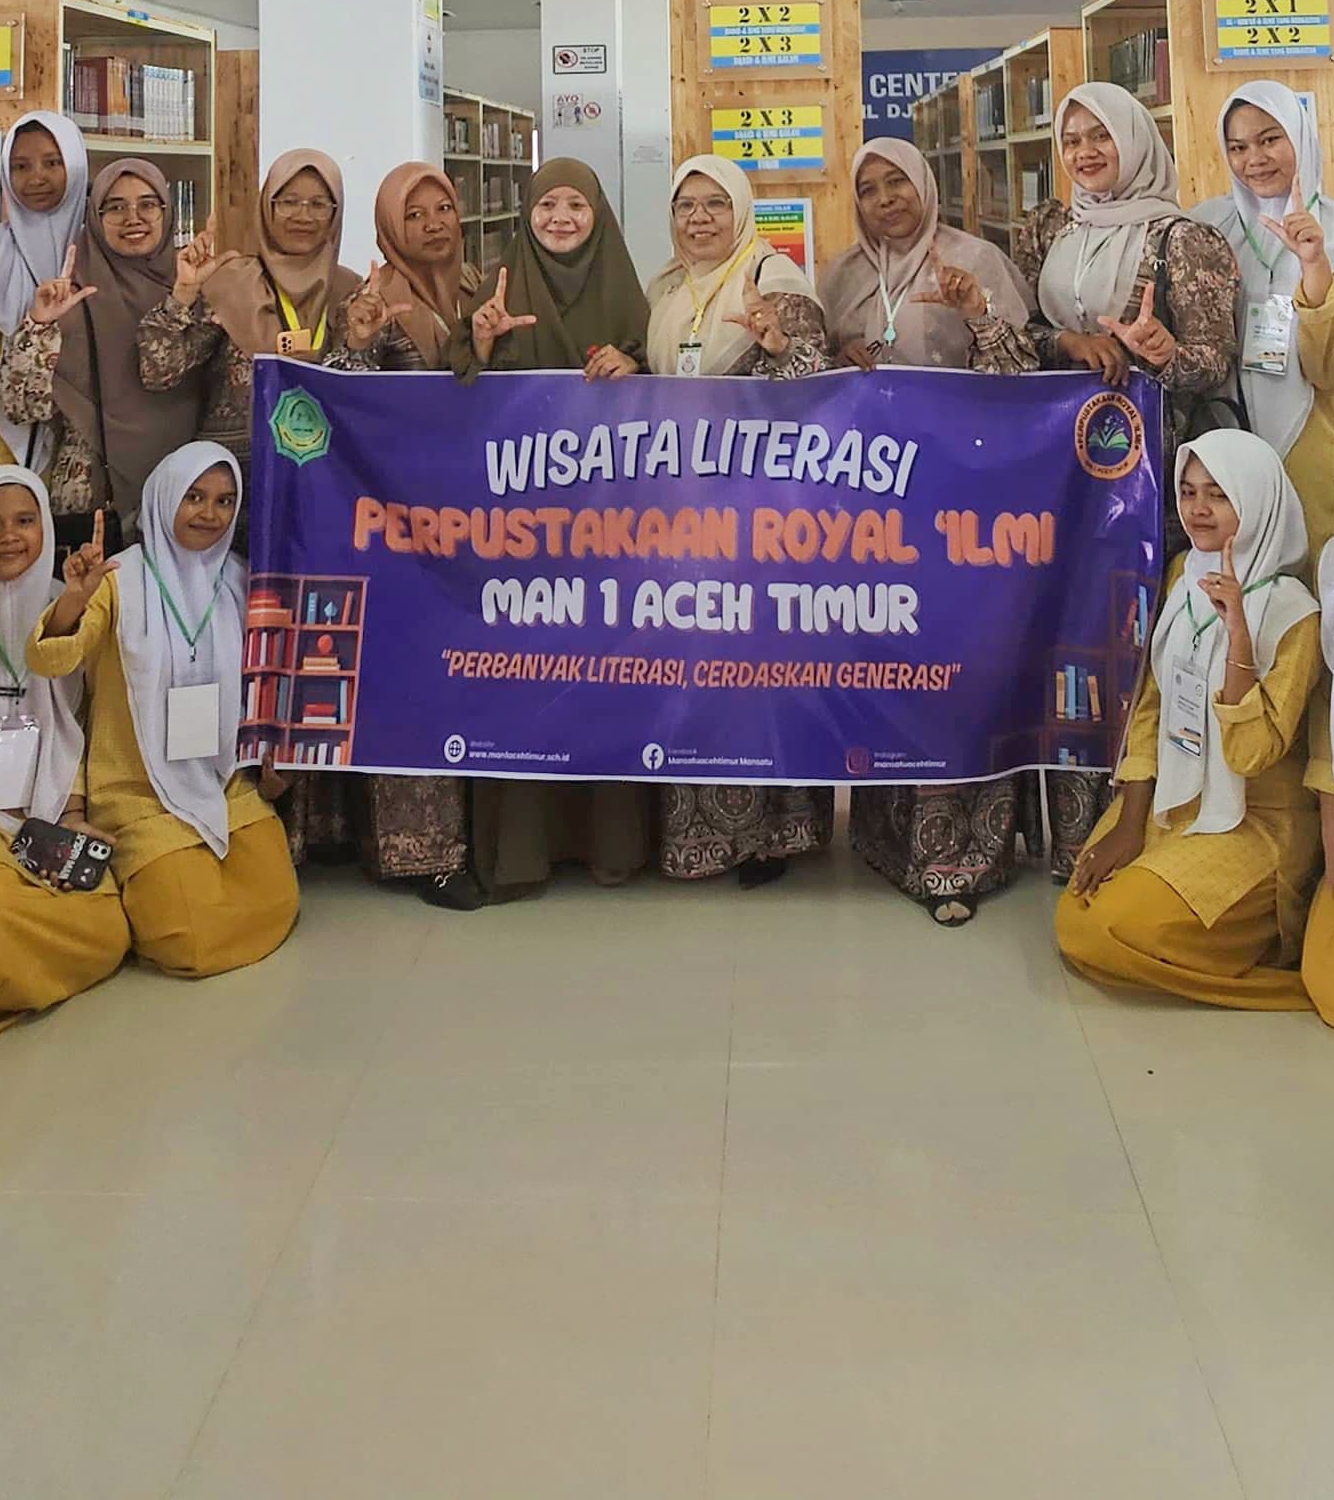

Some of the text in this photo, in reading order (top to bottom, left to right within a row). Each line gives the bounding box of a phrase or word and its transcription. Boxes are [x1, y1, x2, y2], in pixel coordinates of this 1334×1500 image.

[739, 6, 790, 23] 2 X 2
[740, 36, 791, 53] 2 X 3
[1247, 27, 1300, 44] 2 X 2
[741, 109, 793, 127] 2 X 3
[742, 139, 794, 157] 2 X 4
[484, 418, 919, 499] WISATA LITERASI
[352, 496, 737, 560] PERPUSTAKAAN
[751, 507, 920, 565] ROYAL
[480, 576, 920, 635] MAN 1 ACEH TIMUR
[441, 649, 962, 692] "PERBANYAK LITERASI, CERDASKAN GENERASI"
